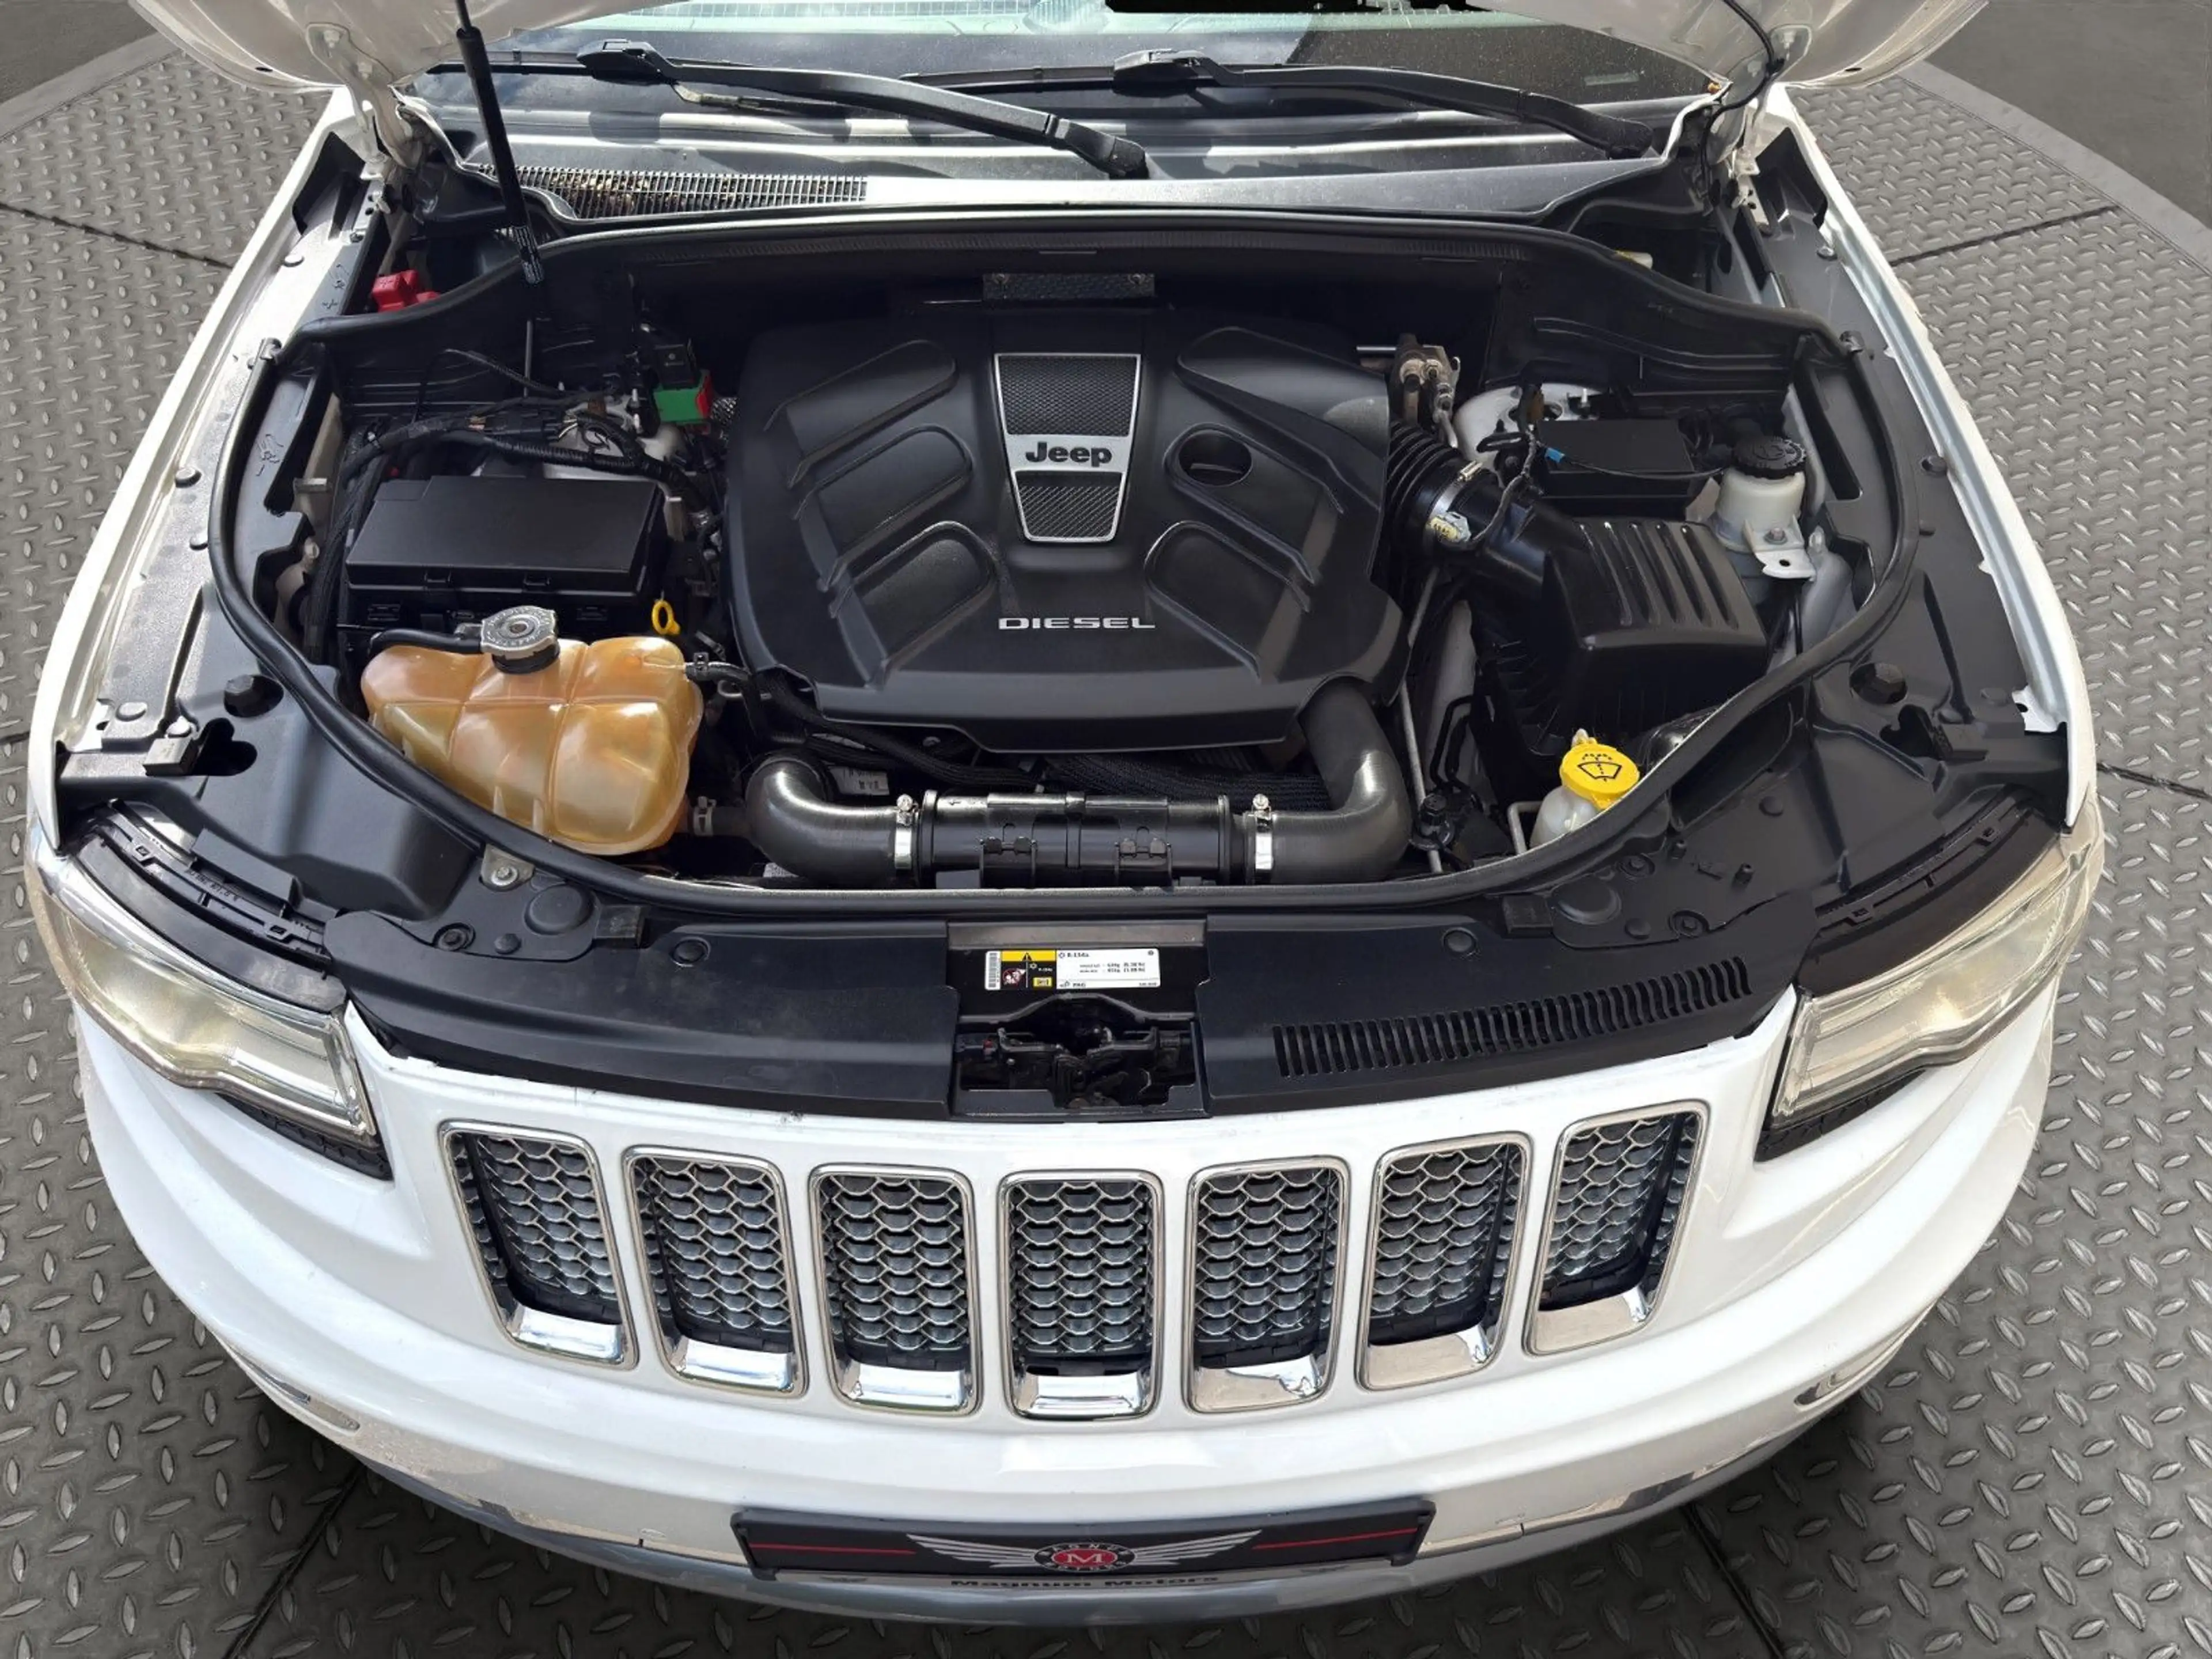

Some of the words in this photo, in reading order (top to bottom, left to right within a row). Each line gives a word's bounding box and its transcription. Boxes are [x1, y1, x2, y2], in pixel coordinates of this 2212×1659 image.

[1025, 442, 1112, 467] Jeep
[998, 618, 1156, 630] DIESEL
[1066, 1554, 1103, 1563] M
